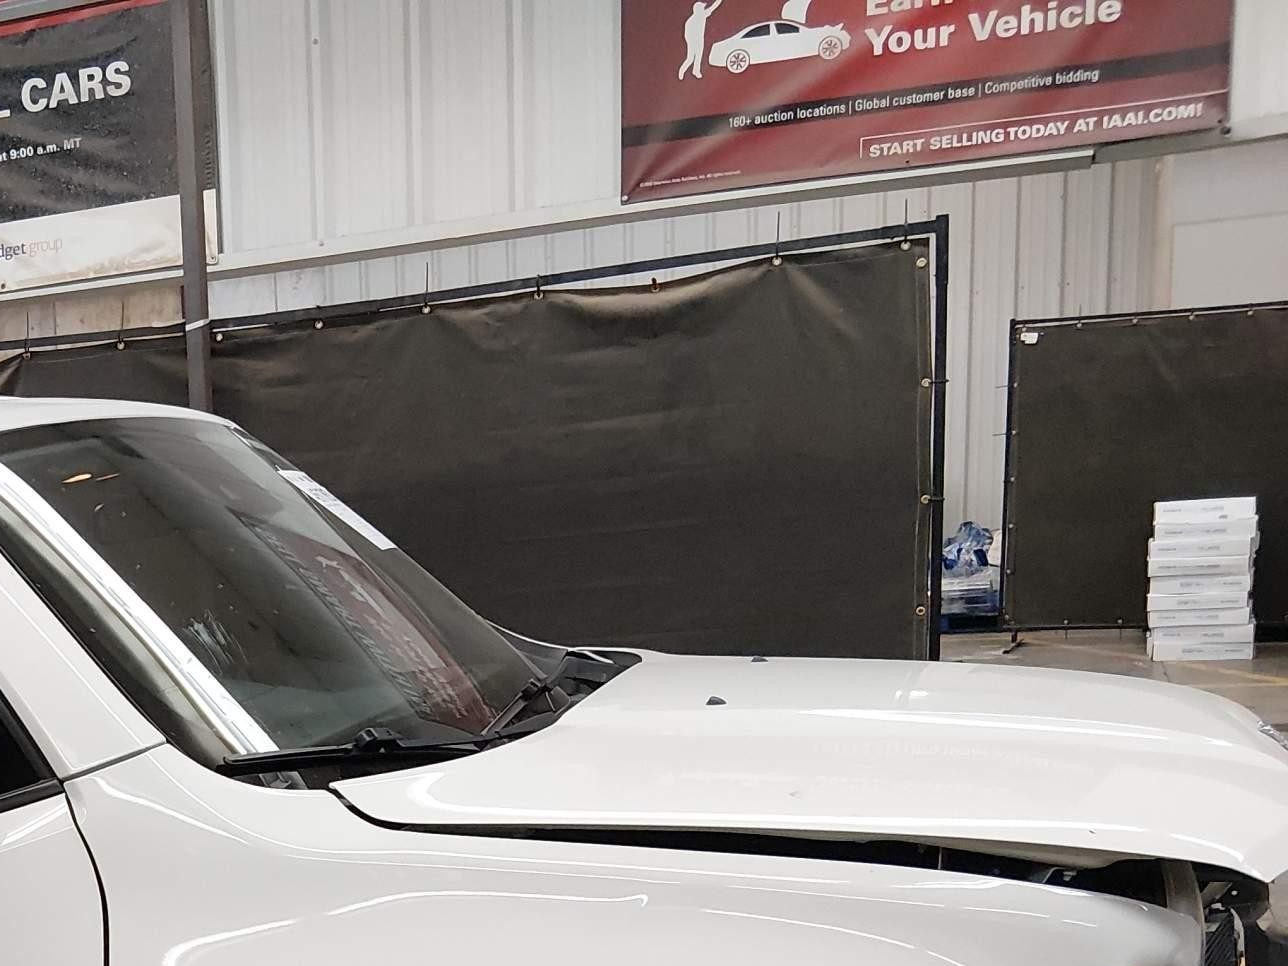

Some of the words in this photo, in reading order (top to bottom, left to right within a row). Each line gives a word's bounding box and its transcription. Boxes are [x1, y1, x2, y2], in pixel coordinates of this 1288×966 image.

[864, 24, 956, 56] Your
[967, 0, 1123, 42] Vehicle
[867, 0, 953, 16] Ea
[21, 60, 133, 114] CARS
[729, 115, 752, 129] 160+
[754, 109, 794, 125] auction
[796, 104, 846, 120] locations
[855, 96, 890, 112] Global
[892, 90, 944, 107] customer
[947, 84, 975, 99] base
[984, 75, 1053, 95] Competitive
[1055, 68, 1100, 86] bidding
[9, 145, 34, 161] 9:00
[36, 143, 60, 157] a.m.
[63, 136, 82, 151] MT
[869, 138, 925, 158] START
[929, 128, 1004, 150] SELLING
[1007, 121, 1069, 141] TODAY
[1073, 116, 1097, 133] AT
[1102, 102, 1204, 130] IAAI.COM!
[28, 236, 64, 259] group
